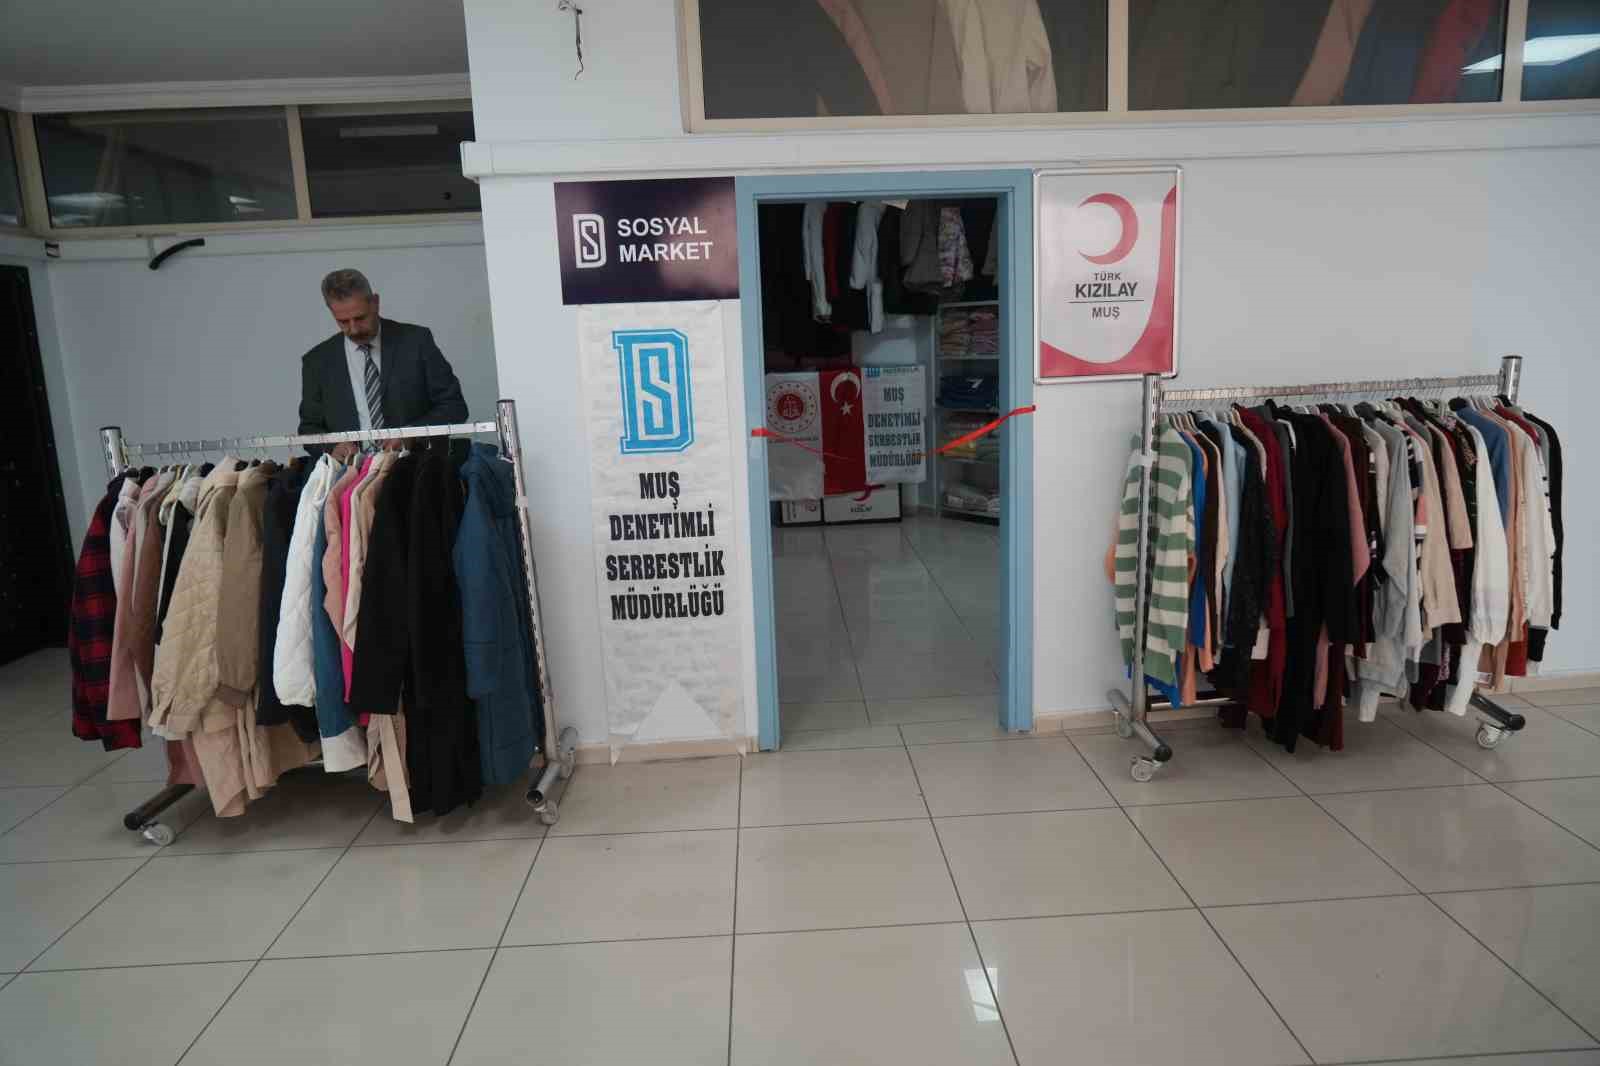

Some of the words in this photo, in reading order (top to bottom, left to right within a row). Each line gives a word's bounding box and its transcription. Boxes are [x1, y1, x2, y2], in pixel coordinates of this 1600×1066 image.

[617, 216, 707, 237] SOSYAL
[619, 241, 713, 263] MARKET
[1094, 271, 1121, 281] TÜRK
[1075, 282, 1138, 298] KIZILAY
[1091, 306, 1120, 319] MUŞ
[883, 387, 905, 406] MUŞ
[639, 471, 681, 510] MUŞ
[609, 503, 715, 541] DENETİMLİ
[606, 543, 725, 581] SERBESTLİK
[610, 583, 725, 621] MÜDÜRLÜĞÜ
